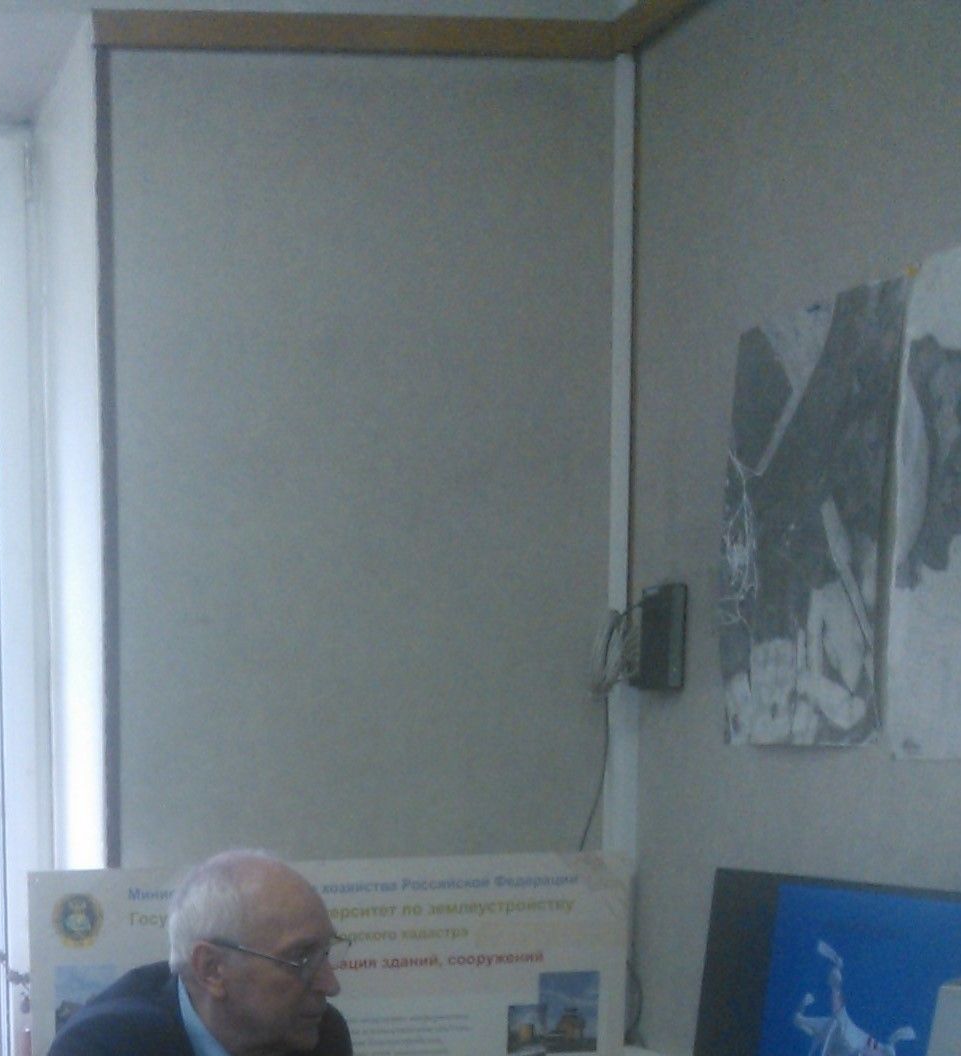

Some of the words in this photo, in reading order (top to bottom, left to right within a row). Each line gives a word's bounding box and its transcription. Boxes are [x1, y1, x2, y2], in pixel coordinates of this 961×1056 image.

[401, 878, 490, 890] Российской
[494, 875, 579, 888] Федерации
[402, 904, 422, 915] по
[429, 898, 574, 917] землеустройству
[130, 911, 168, 928] Госу
[402, 927, 469, 940] кадастра
[447, 950, 544, 967] сооружений
